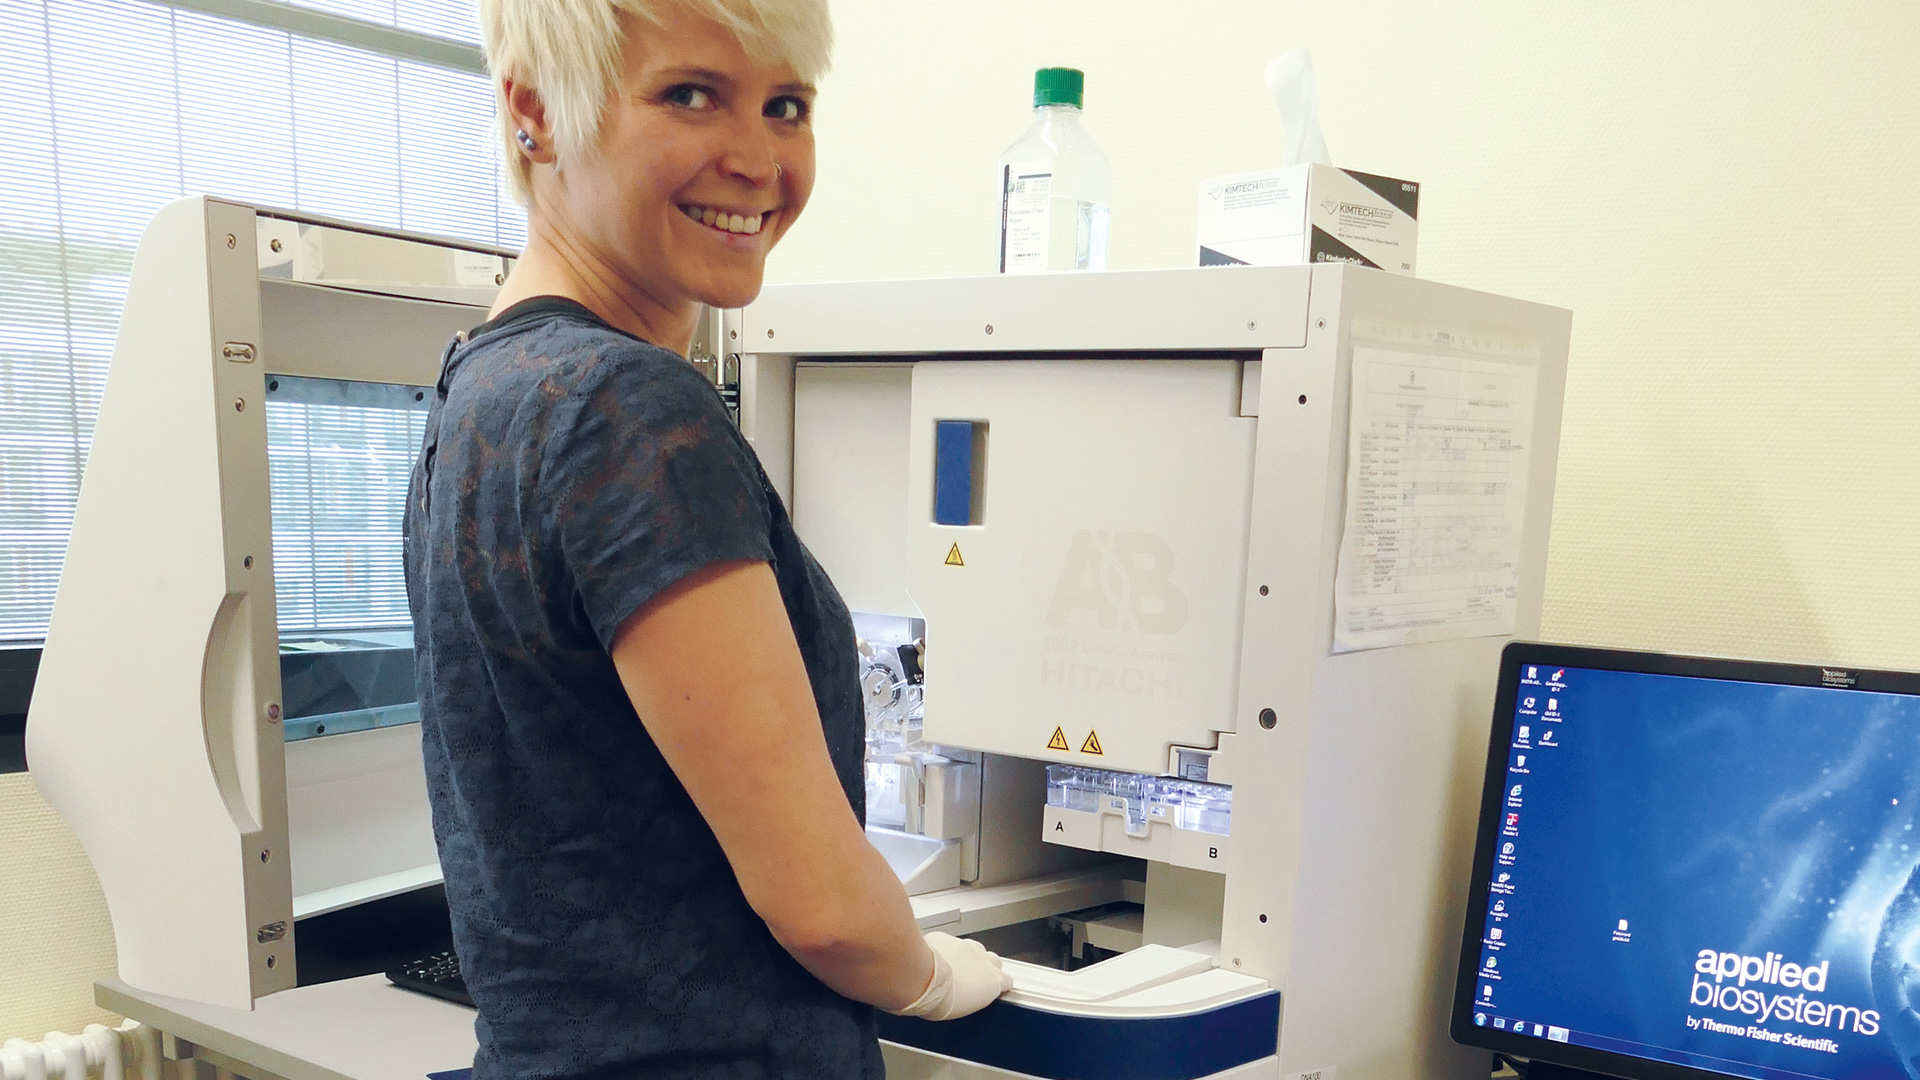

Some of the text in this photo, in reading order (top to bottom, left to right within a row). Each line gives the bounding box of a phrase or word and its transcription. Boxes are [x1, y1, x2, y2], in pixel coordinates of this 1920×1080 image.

[1339, 202, 1374, 217] KIMTECH
[1055, 821, 1065, 832] A
[1208, 847, 1218, 858] B
[1695, 948, 1829, 992] applied
[1690, 973, 1880, 1036] biosystems
[1686, 1015, 1839, 1054] by Thermo Fisher Scientific
